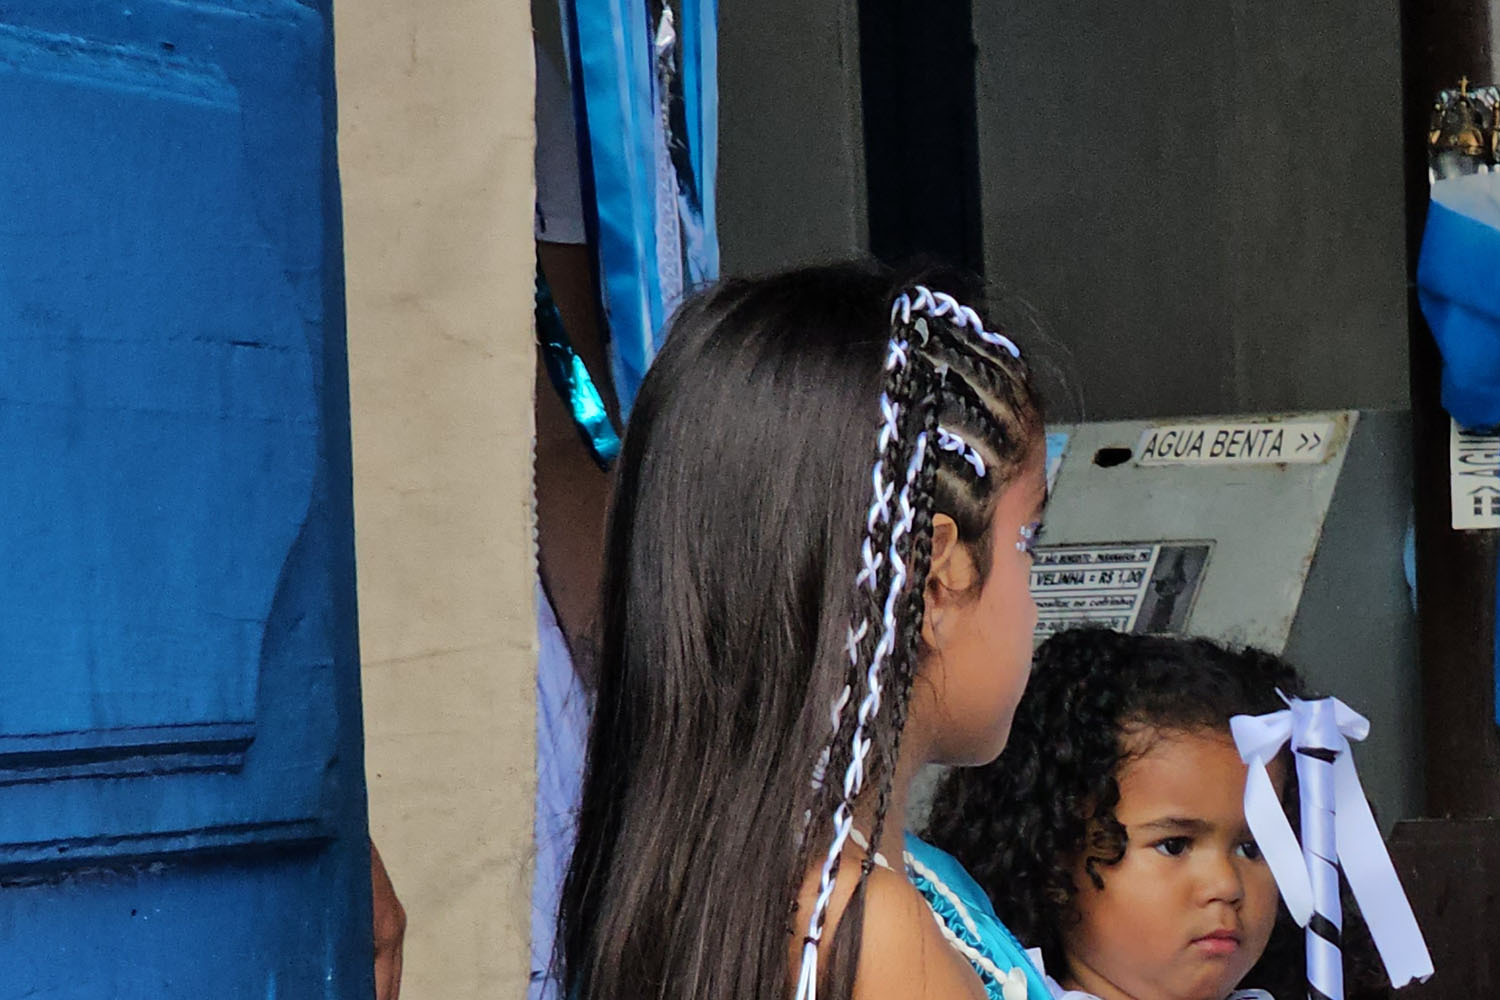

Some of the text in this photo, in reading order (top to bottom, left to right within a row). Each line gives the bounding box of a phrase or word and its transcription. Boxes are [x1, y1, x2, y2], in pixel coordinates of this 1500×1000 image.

[1141, 429, 1284, 460] AGUA BENTA
[1098, 571, 1115, 584] R$
